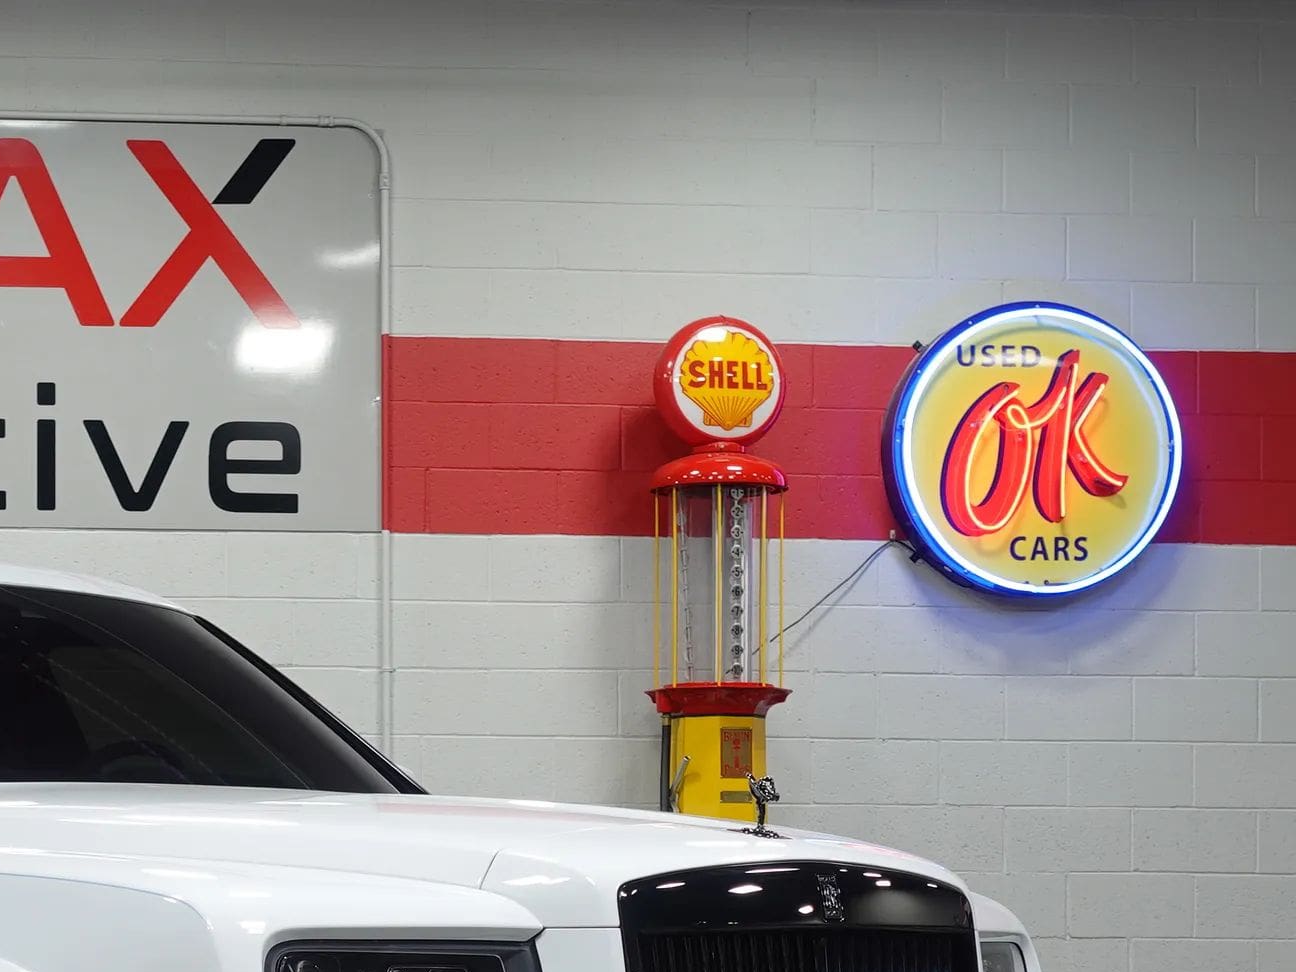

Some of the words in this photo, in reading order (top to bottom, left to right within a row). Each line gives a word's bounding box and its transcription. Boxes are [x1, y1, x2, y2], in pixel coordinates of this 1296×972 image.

[955, 344, 1042, 368] USED
[688, 359, 767, 391] SHELL
[940, 349, 1129, 537] OK
[1008, 535, 1089, 562] CARS
